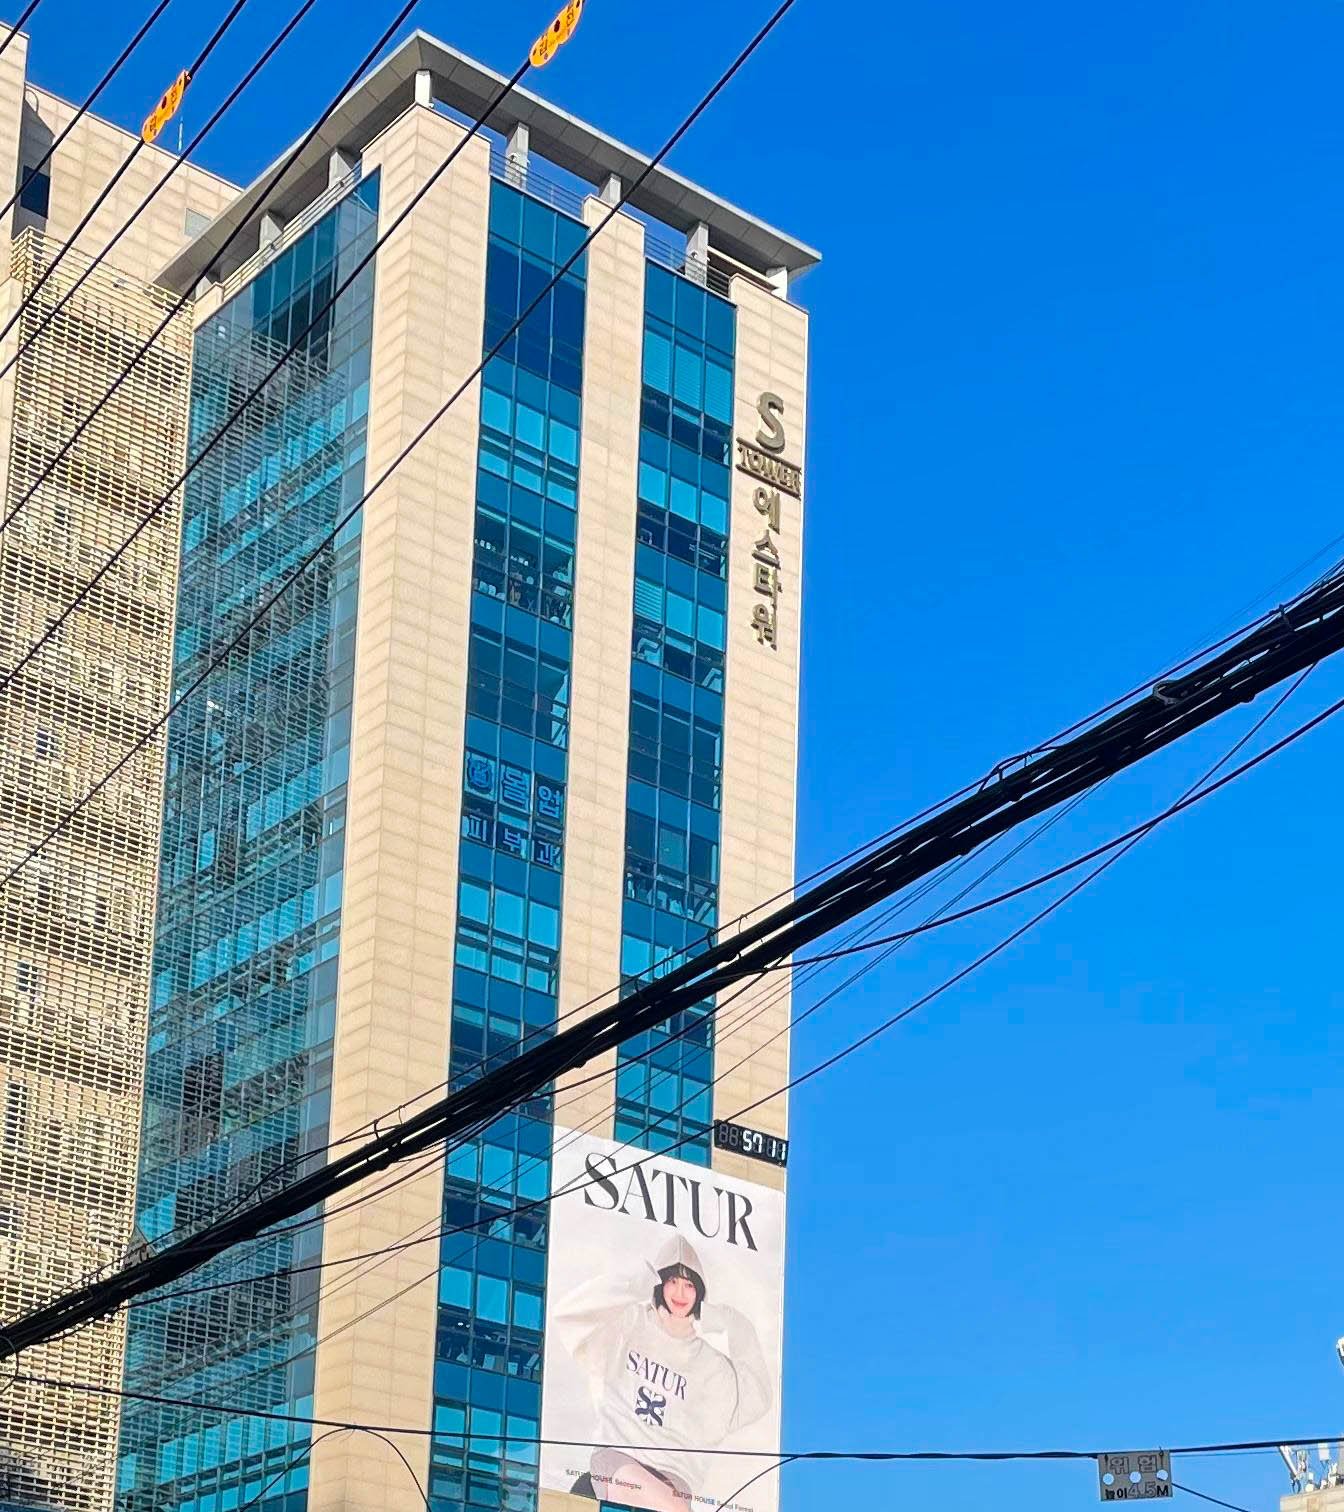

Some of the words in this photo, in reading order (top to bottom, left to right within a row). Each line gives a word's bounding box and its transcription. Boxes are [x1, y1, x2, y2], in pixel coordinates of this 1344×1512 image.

[756, 391, 785, 454] S
[737, 446, 802, 489] TOWER
[750, 486, 783, 651] 에스타워
[583, 1152, 758, 1252] SATUR
[626, 1350, 687, 1400] SATUR
[1109, 1455, 1158, 1475] 위험
